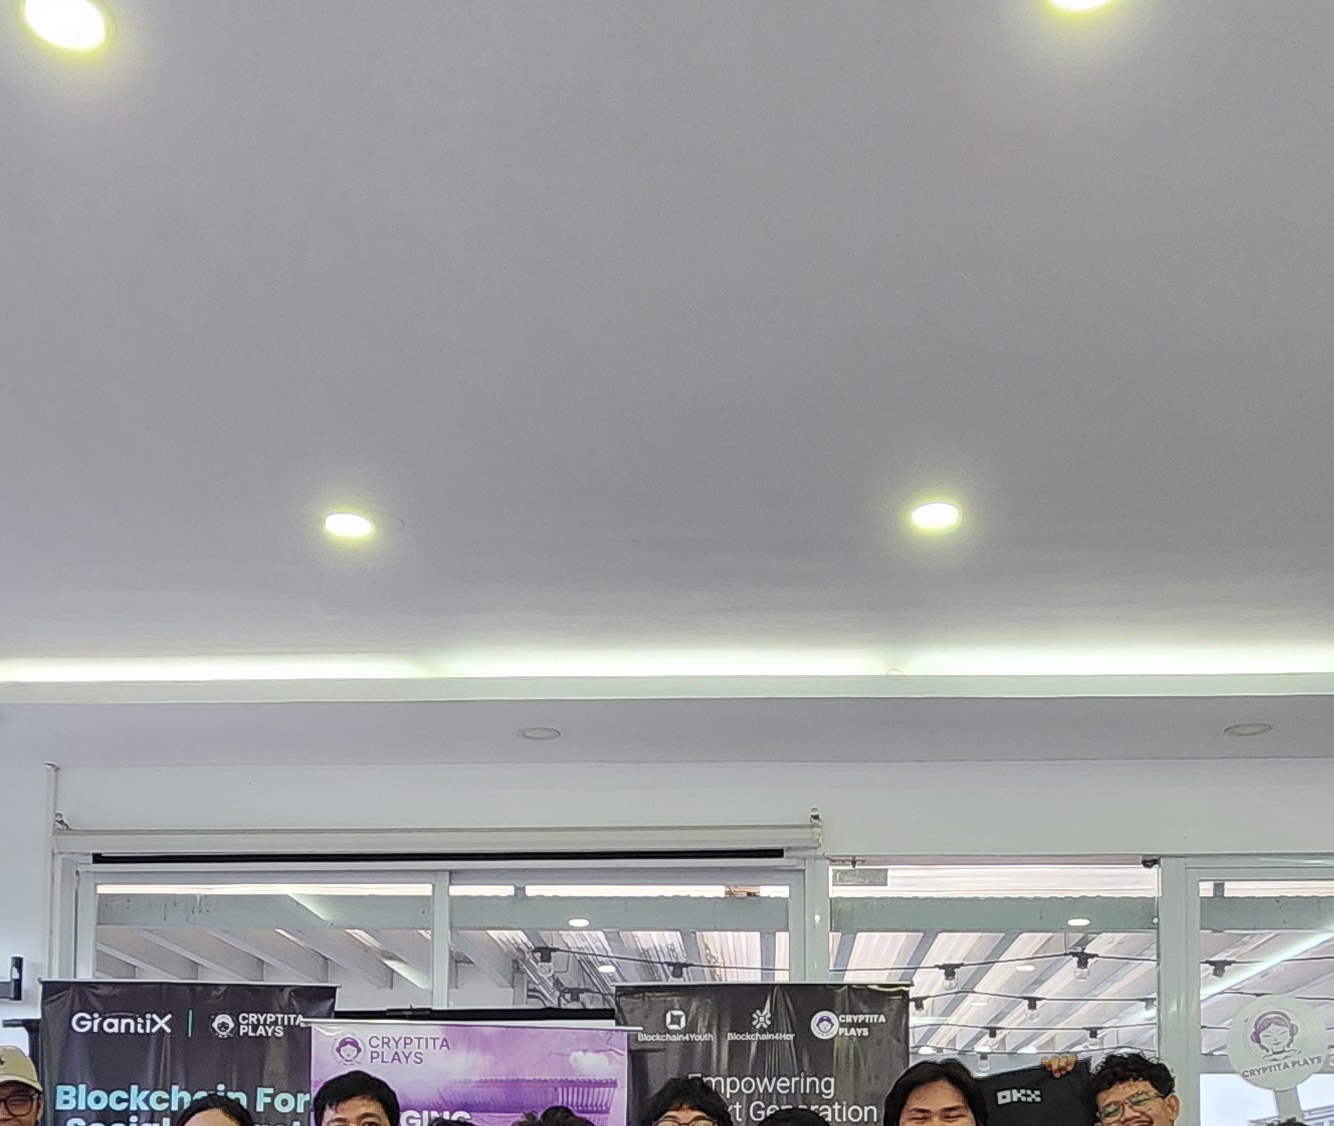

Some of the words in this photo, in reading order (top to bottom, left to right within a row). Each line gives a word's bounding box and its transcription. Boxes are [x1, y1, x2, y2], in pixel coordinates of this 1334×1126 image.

[238, 1013, 305, 1027] CRYPTITA
[838, 1014, 886, 1024] CRYPTITA
[238, 1025, 285, 1038] PLAYS
[637, 1032, 714, 1042] Blockchain4Youth
[727, 1032, 795, 1042] Blockchain4Her
[838, 1027, 869, 1037] PLAYS
[368, 1035, 451, 1052] CRYPTITA
[369, 1050, 424, 1065] PLAYS
[1242, 1062, 1290, 1078] CRYPTITA
[1291, 1055, 1322, 1068] PLAYS
[255, 1086, 310, 1113] For
[996, 1088, 1041, 1105] OKX
